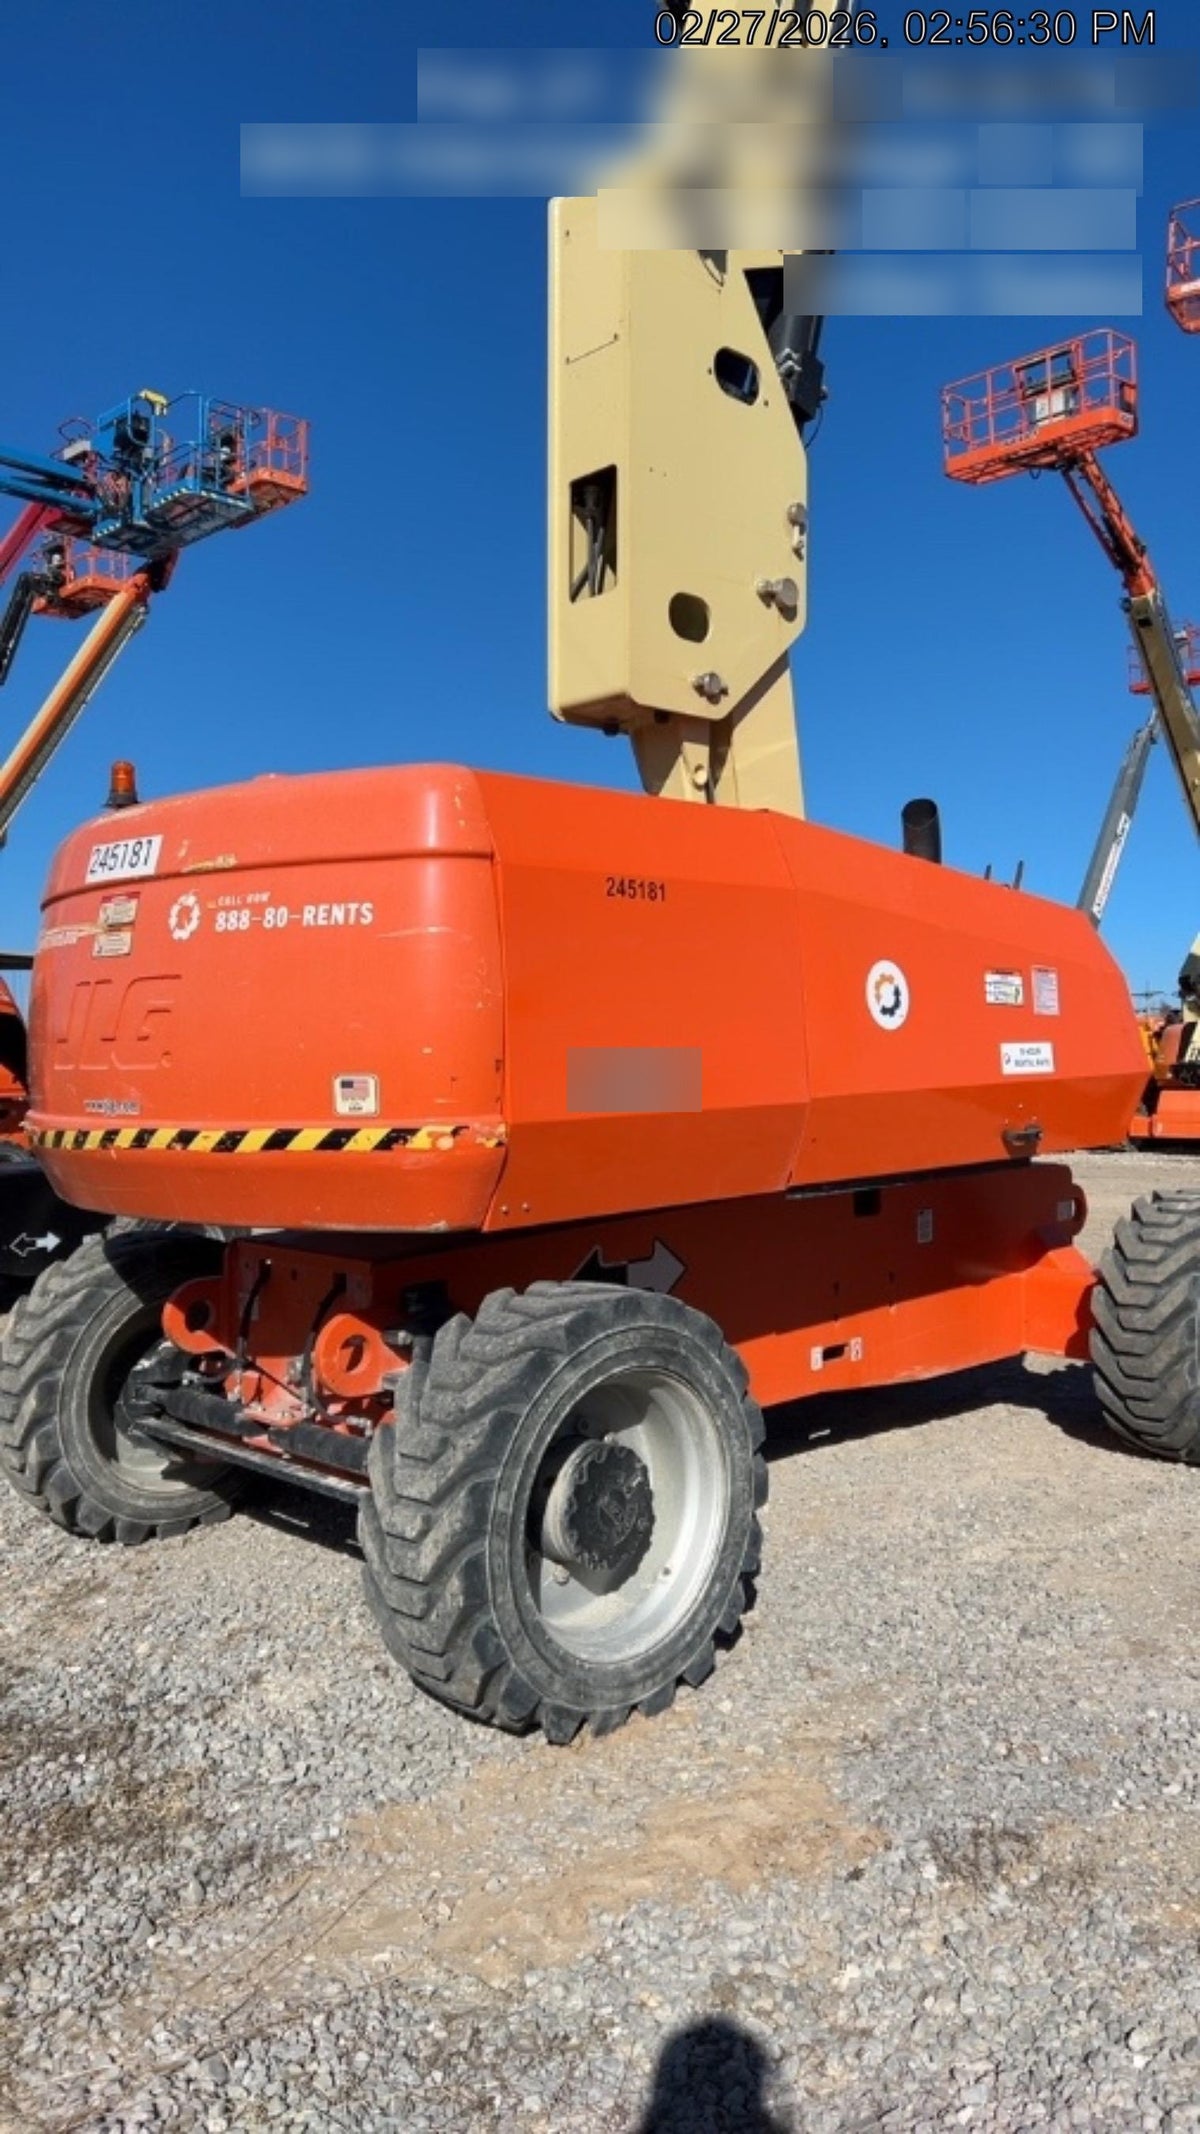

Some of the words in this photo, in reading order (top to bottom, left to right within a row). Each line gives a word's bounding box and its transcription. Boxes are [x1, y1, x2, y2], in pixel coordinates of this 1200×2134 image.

[89, 838, 153, 875] 245181
[605, 876, 666, 902] 245181
[214, 902, 375, 933] 888-80-RENTS
